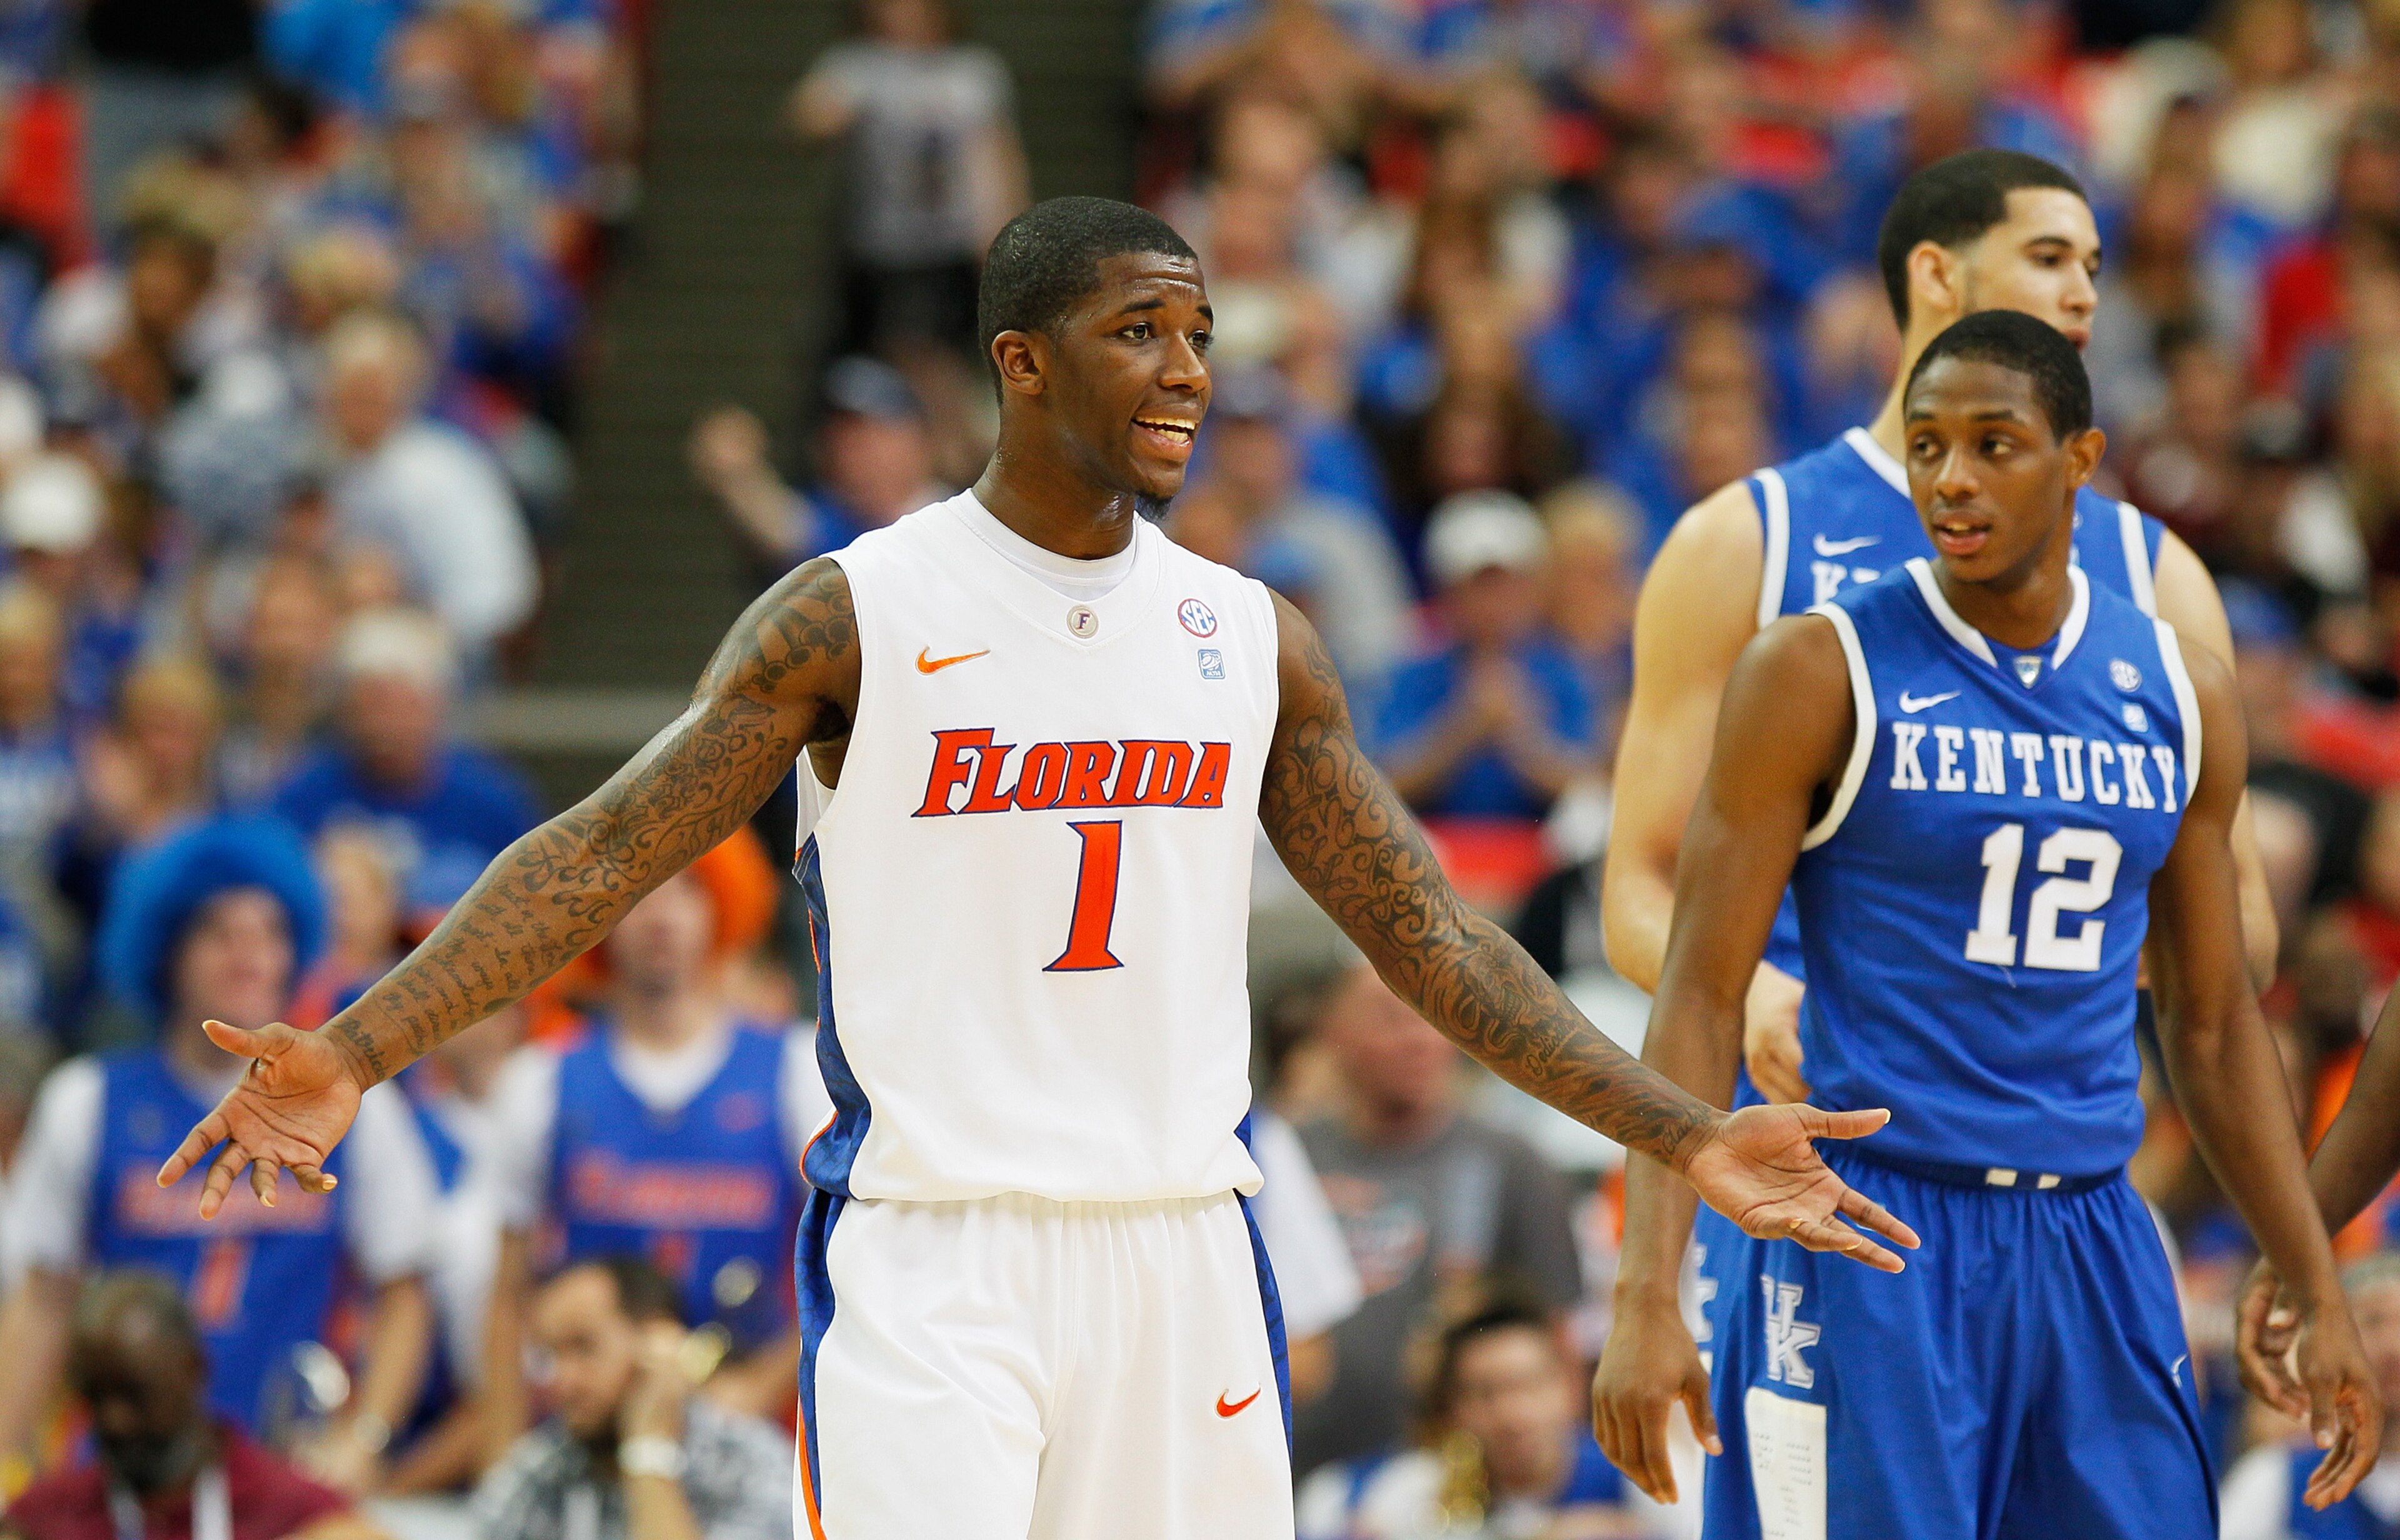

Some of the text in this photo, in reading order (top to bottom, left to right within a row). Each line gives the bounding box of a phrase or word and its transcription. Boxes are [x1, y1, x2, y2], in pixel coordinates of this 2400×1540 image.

[1076, 612, 1091, 630] F
[1180, 599, 1216, 635] SEC
[911, 727, 1231, 818] FLORIDA
[1889, 720, 2178, 814] KENTUCKY
[1042, 820, 1124, 972] 1
[1964, 822, 2124, 972] 12
[1760, 1273, 1821, 1389] UK
